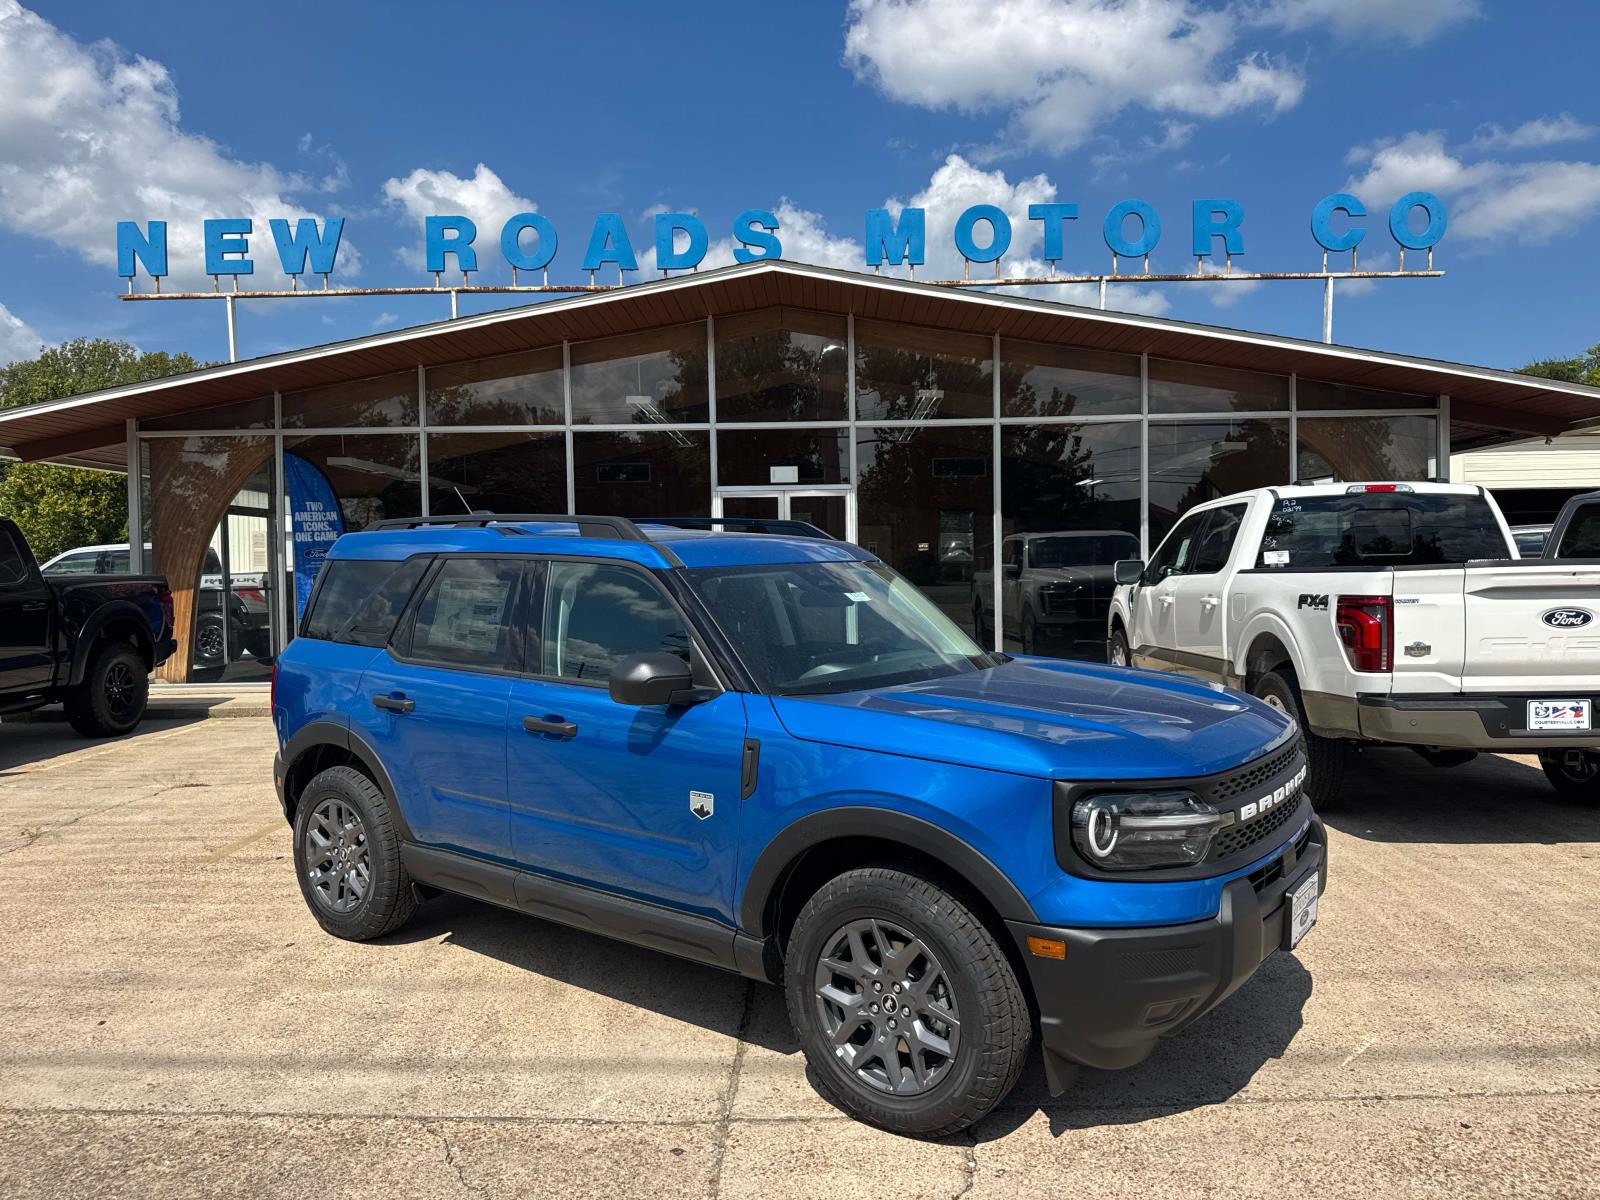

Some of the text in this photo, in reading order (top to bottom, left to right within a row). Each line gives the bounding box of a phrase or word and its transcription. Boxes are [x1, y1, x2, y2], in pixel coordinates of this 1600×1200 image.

[117, 192, 1447, 277] NEW ROADS MOTOR CO
[305, 502, 323, 511] TWO
[295, 511, 338, 521] AMERICAN
[303, 521, 332, 531] ICONS.
[295, 531, 313, 542] ONE
[1297, 594, 1329, 610] FX4
[1551, 611, 1584, 625] Ford
[1241, 764, 1307, 821] BRONCO
